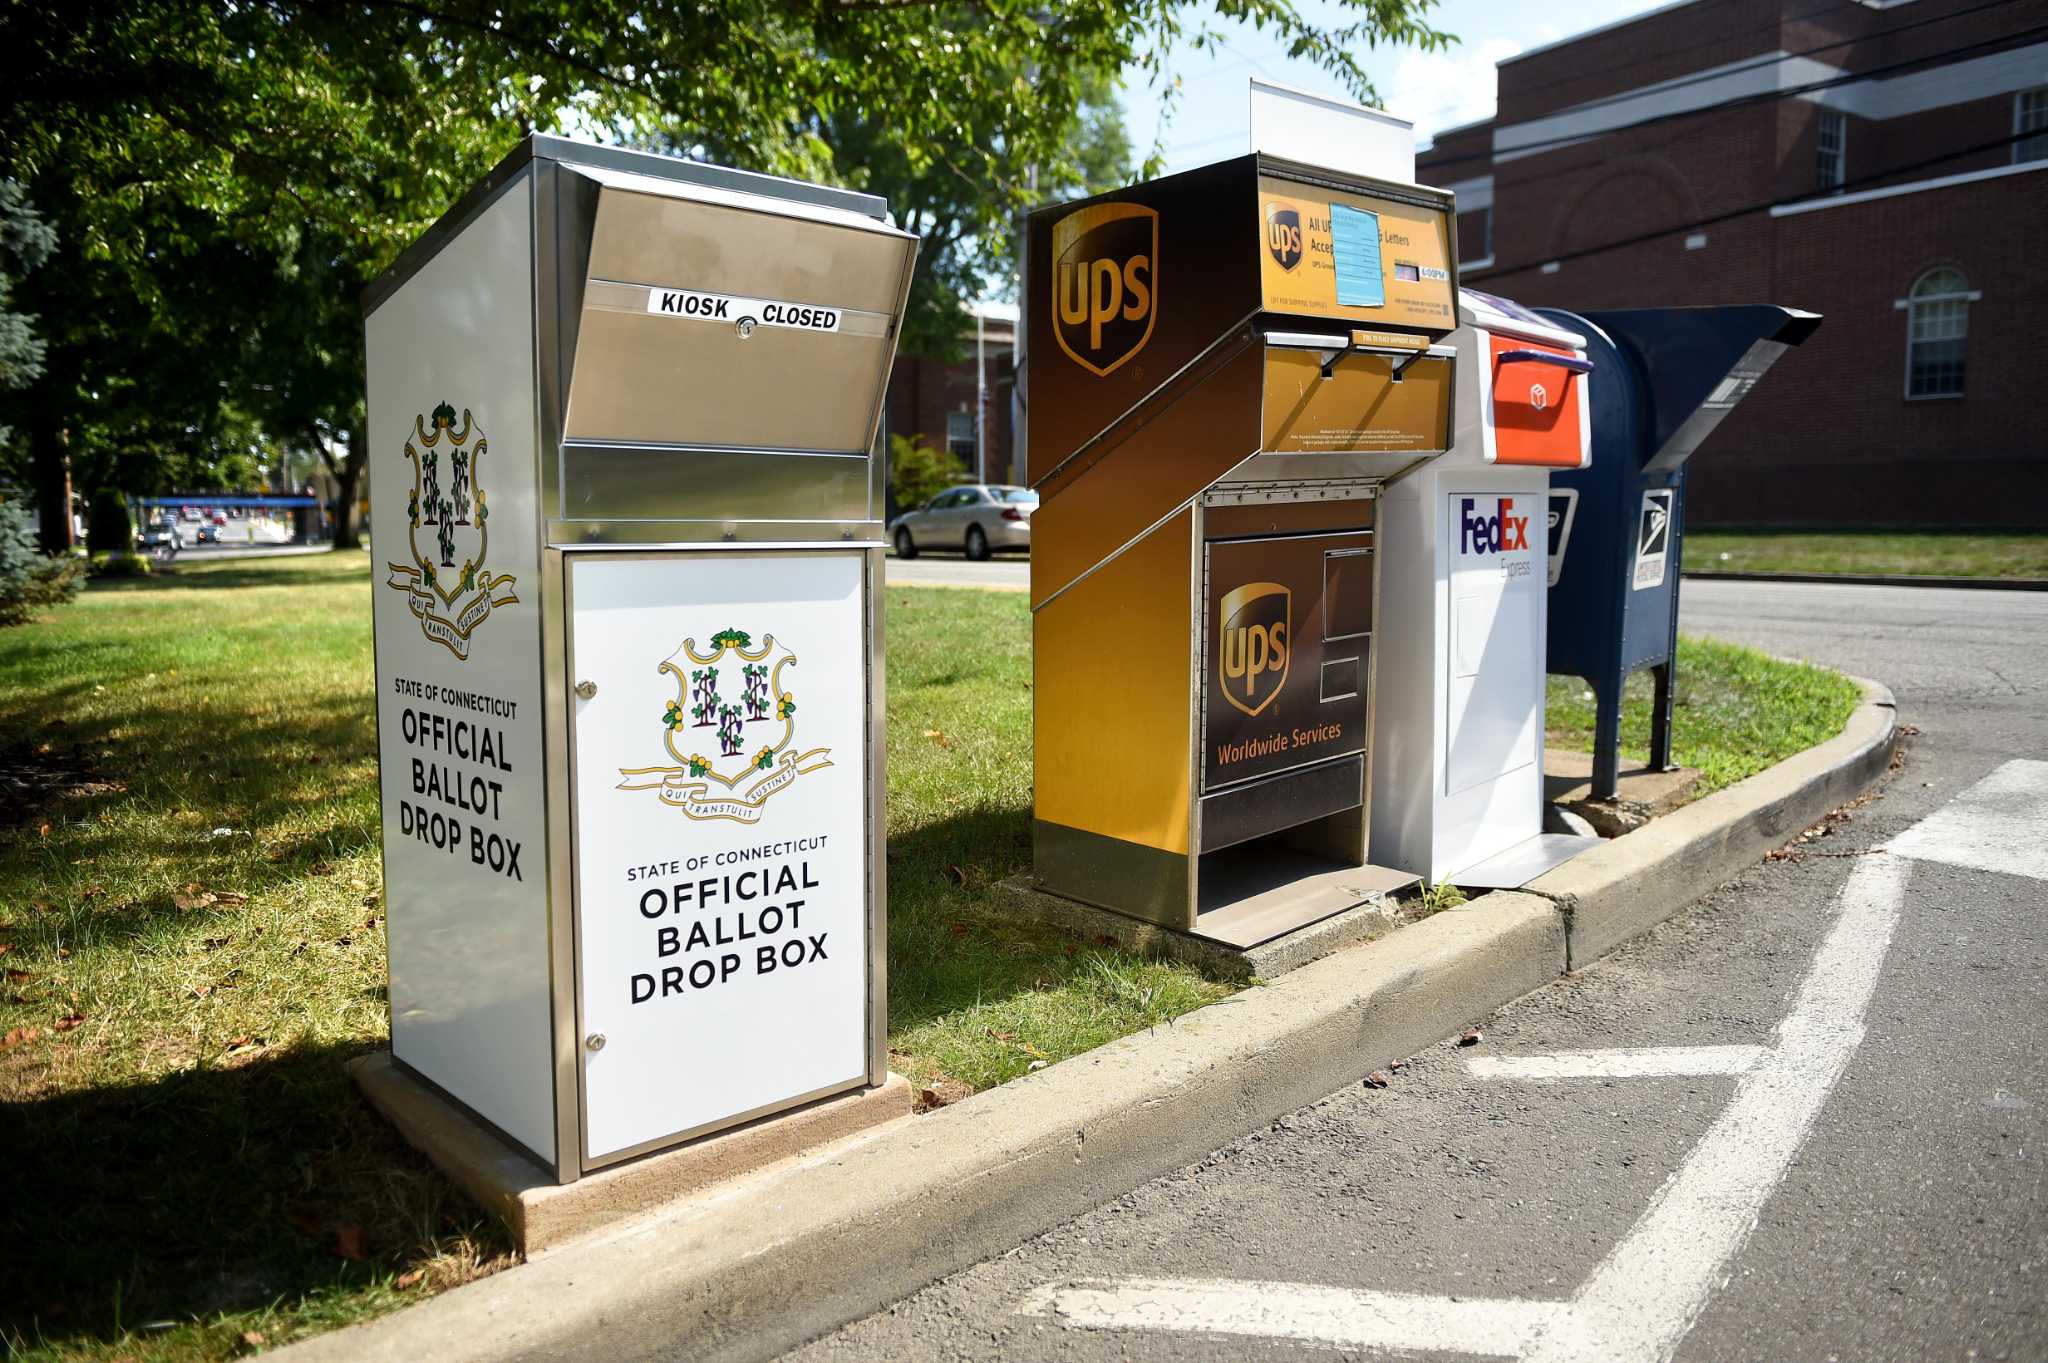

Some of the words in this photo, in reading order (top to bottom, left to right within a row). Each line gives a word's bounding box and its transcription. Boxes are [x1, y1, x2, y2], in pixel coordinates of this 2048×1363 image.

[1268, 223, 1301, 262] ups
[1309, 216, 1320, 231] All
[1322, 219, 1332, 233] UP
[1385, 230, 1410, 246] Letters
[661, 292, 730, 318] KIOSK
[762, 304, 837, 329] CLOSED
[1060, 254, 1150, 350] ups
[1461, 498, 1529, 555] FedEx
[1501, 557, 1531, 580] Express
[411, 595, 424, 609] QUI
[460, 597, 490, 630] SUSTINET
[1225, 620, 1286, 697] ups
[395, 677, 422, 698] STATE
[425, 684, 438, 701] OF
[441, 688, 517, 720] CONNECTICUT
[402, 708, 512, 772] OFFICIAL
[1218, 734, 1288, 767] Worldwide
[1292, 721, 1341, 749] Services
[413, 758, 503, 821] BALLOT
[665, 788, 687, 800] QUI
[750, 769, 792, 802] SUSTINET
[688, 803, 754, 818] TRANSTULIT
[400, 800, 461, 855] DROP
[470, 824, 523, 882] BOX
[628, 860, 680, 881] STATE
[686, 855, 709, 872] OF
[715, 835, 828, 867] CONNECTICUT
[639, 861, 819, 919] OFFICIAL
[658, 900, 806, 958] BALLOT
[631, 953, 741, 1005] DROP
[756, 933, 829, 975] BOX
